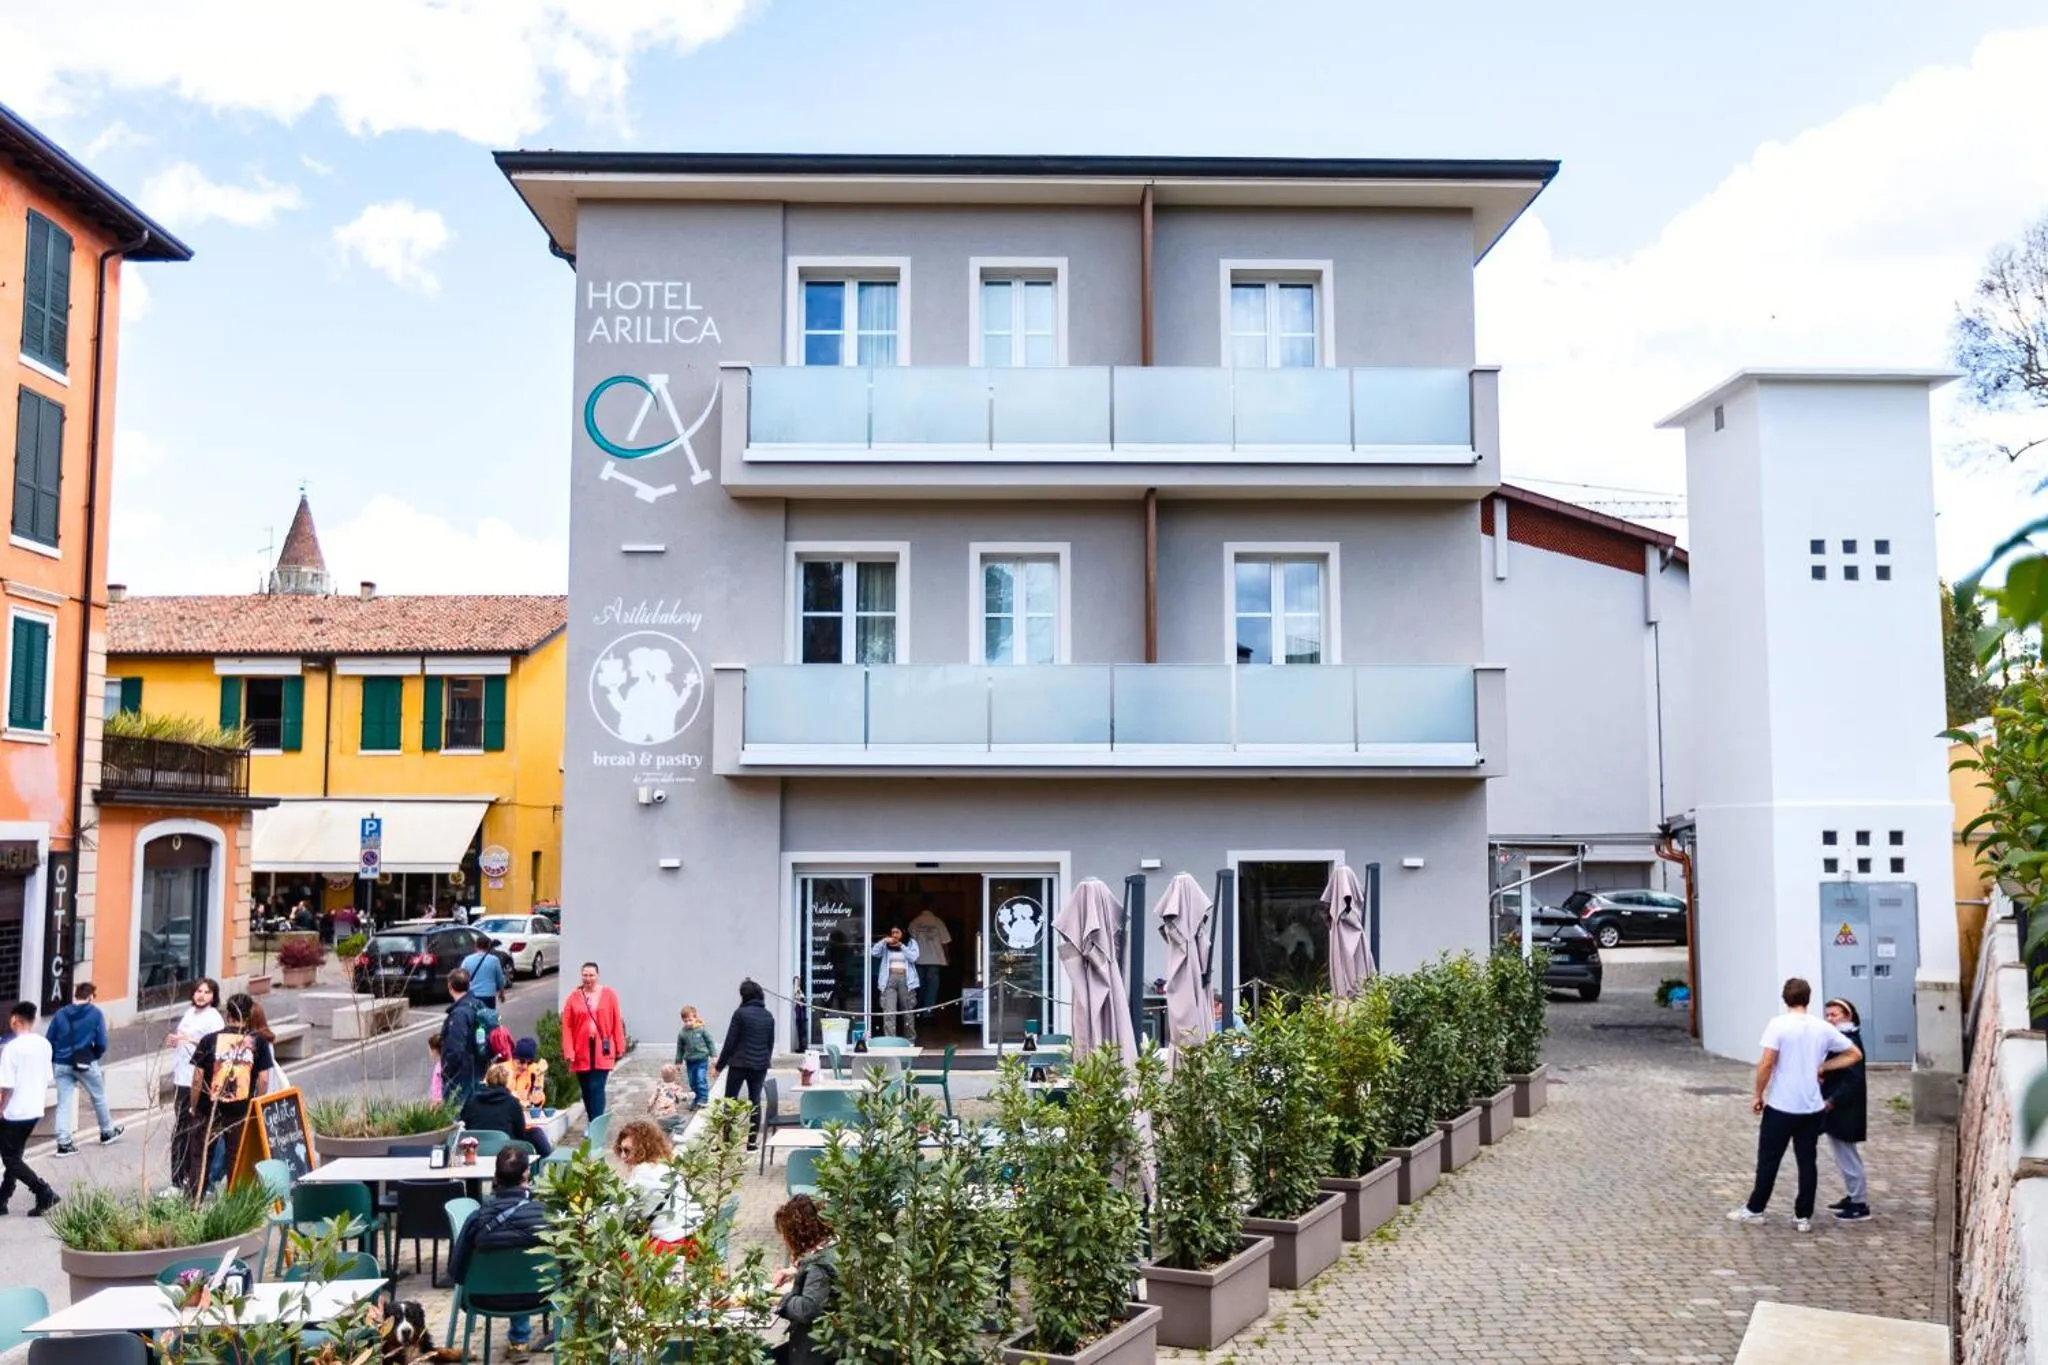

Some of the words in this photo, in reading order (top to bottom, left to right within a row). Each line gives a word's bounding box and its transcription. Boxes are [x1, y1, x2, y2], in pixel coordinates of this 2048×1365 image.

[587, 280, 703, 310] HOTEL
[587, 315, 722, 344] ARILICA
[593, 751, 636, 767] bread
[639, 751, 653, 767] &
[656, 753, 703, 770] pastry
[51, 864, 68, 1001] OTTICA
